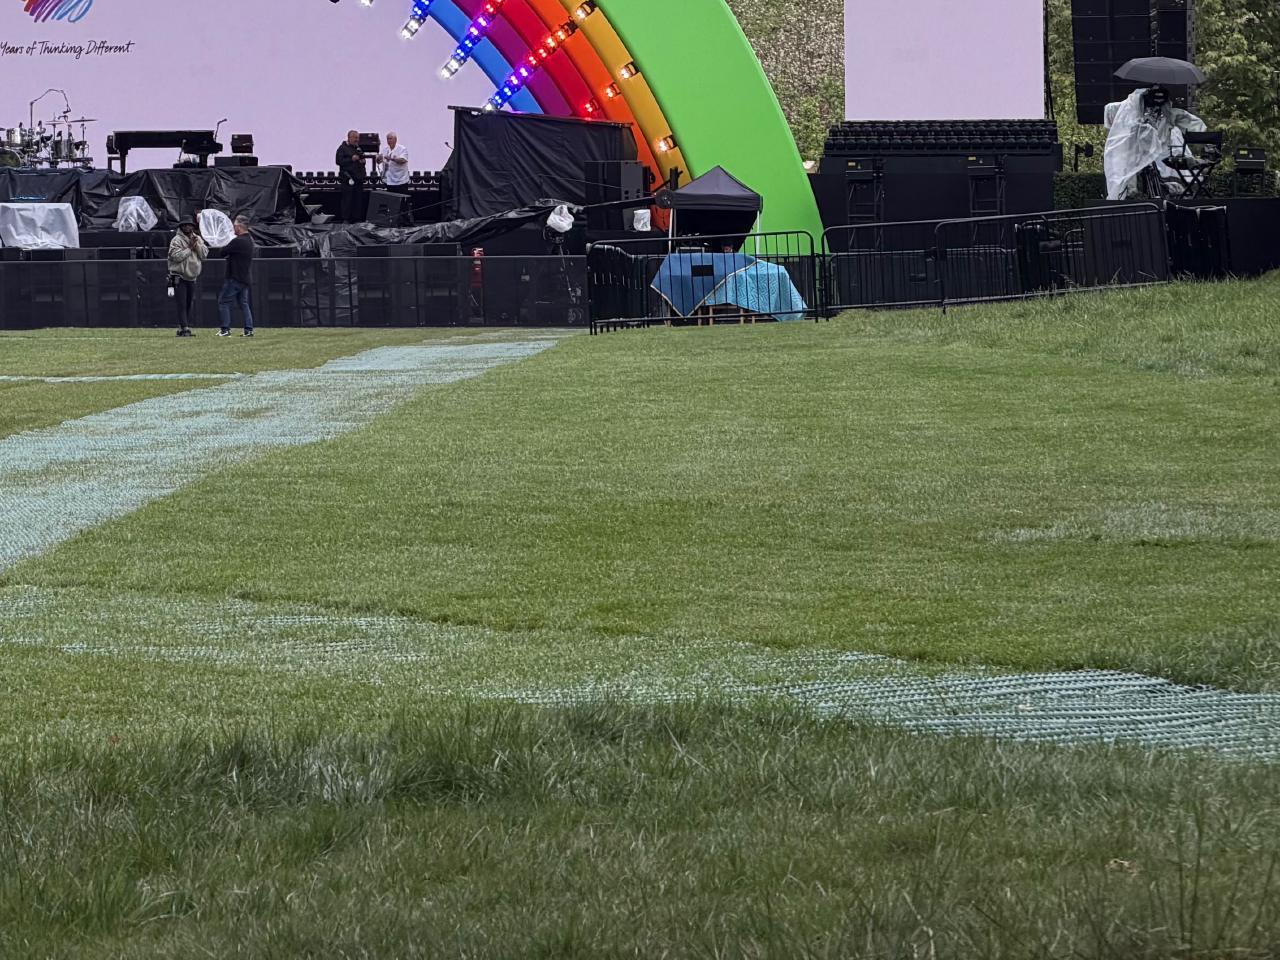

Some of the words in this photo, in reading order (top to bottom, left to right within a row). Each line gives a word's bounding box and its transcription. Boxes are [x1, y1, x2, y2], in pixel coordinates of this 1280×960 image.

[0, 41, 24, 56] Years
[26, 41, 37, 56] of
[38, 40, 85, 59] Thinking
